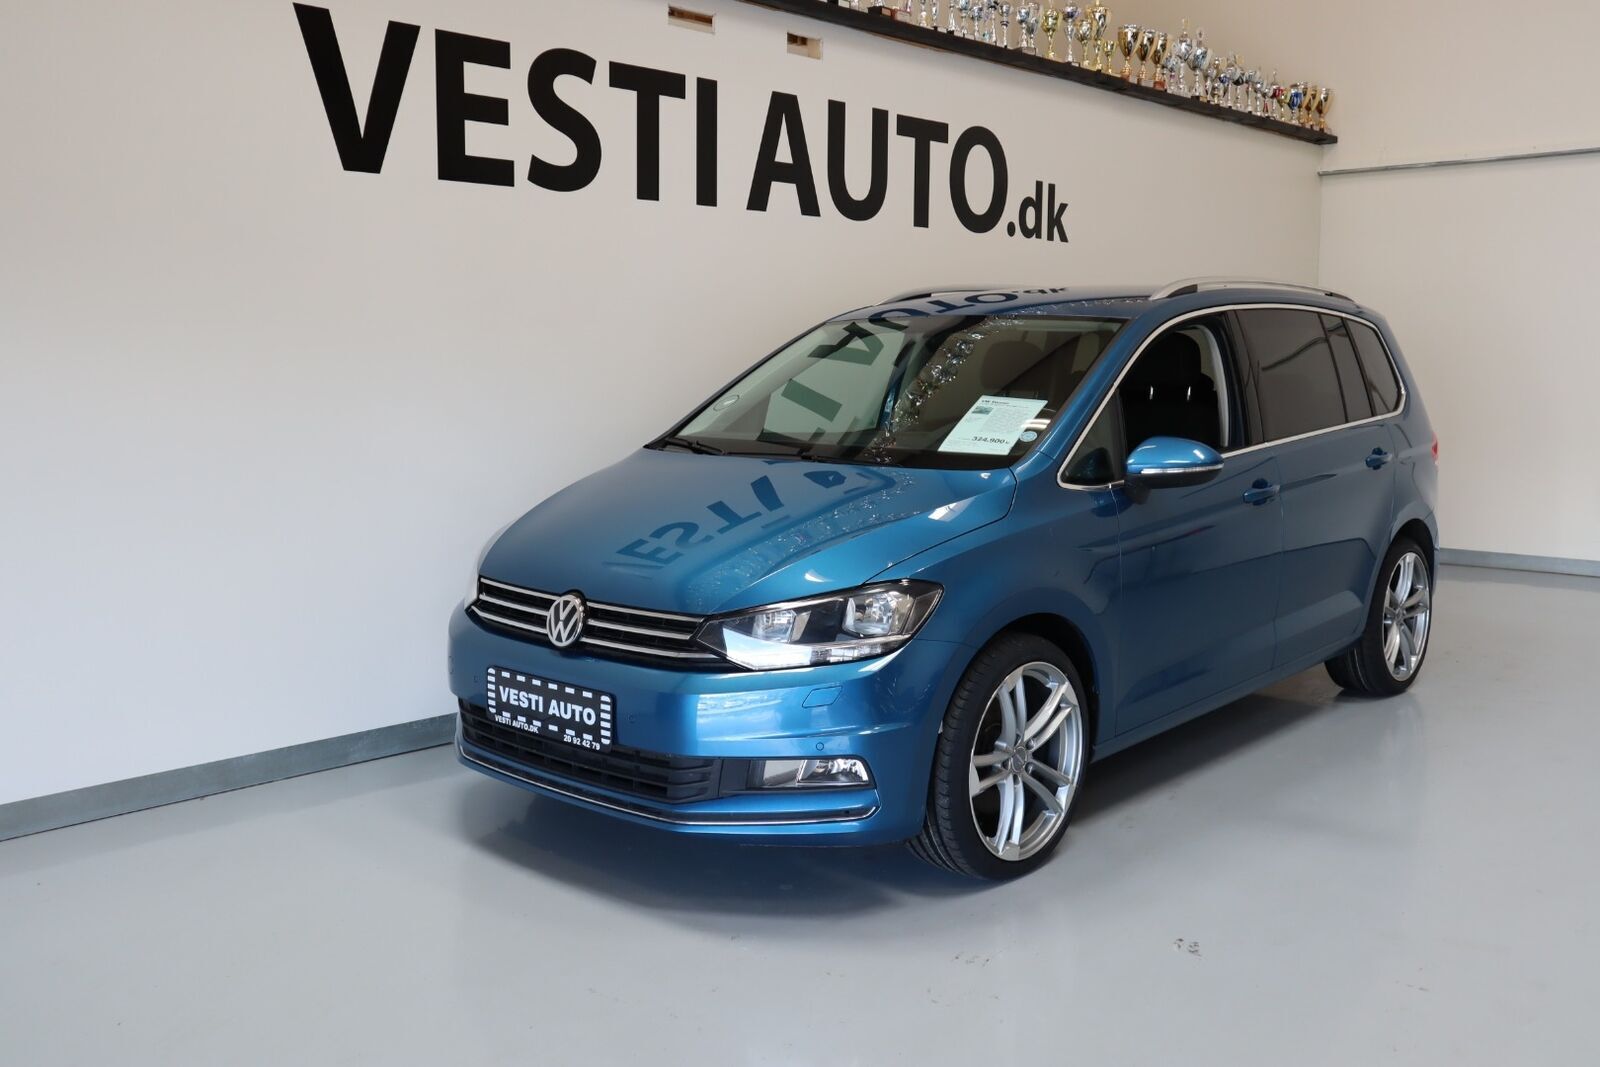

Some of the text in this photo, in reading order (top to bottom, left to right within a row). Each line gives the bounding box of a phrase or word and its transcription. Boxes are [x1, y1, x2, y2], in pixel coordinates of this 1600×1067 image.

[293, 3, 717, 207] VESTI
[499, 686, 596, 725] VESTI AUTO
[495, 714, 539, 733] VESTI AUTO.DK
[563, 734, 600, 751] 20 92 42 79
